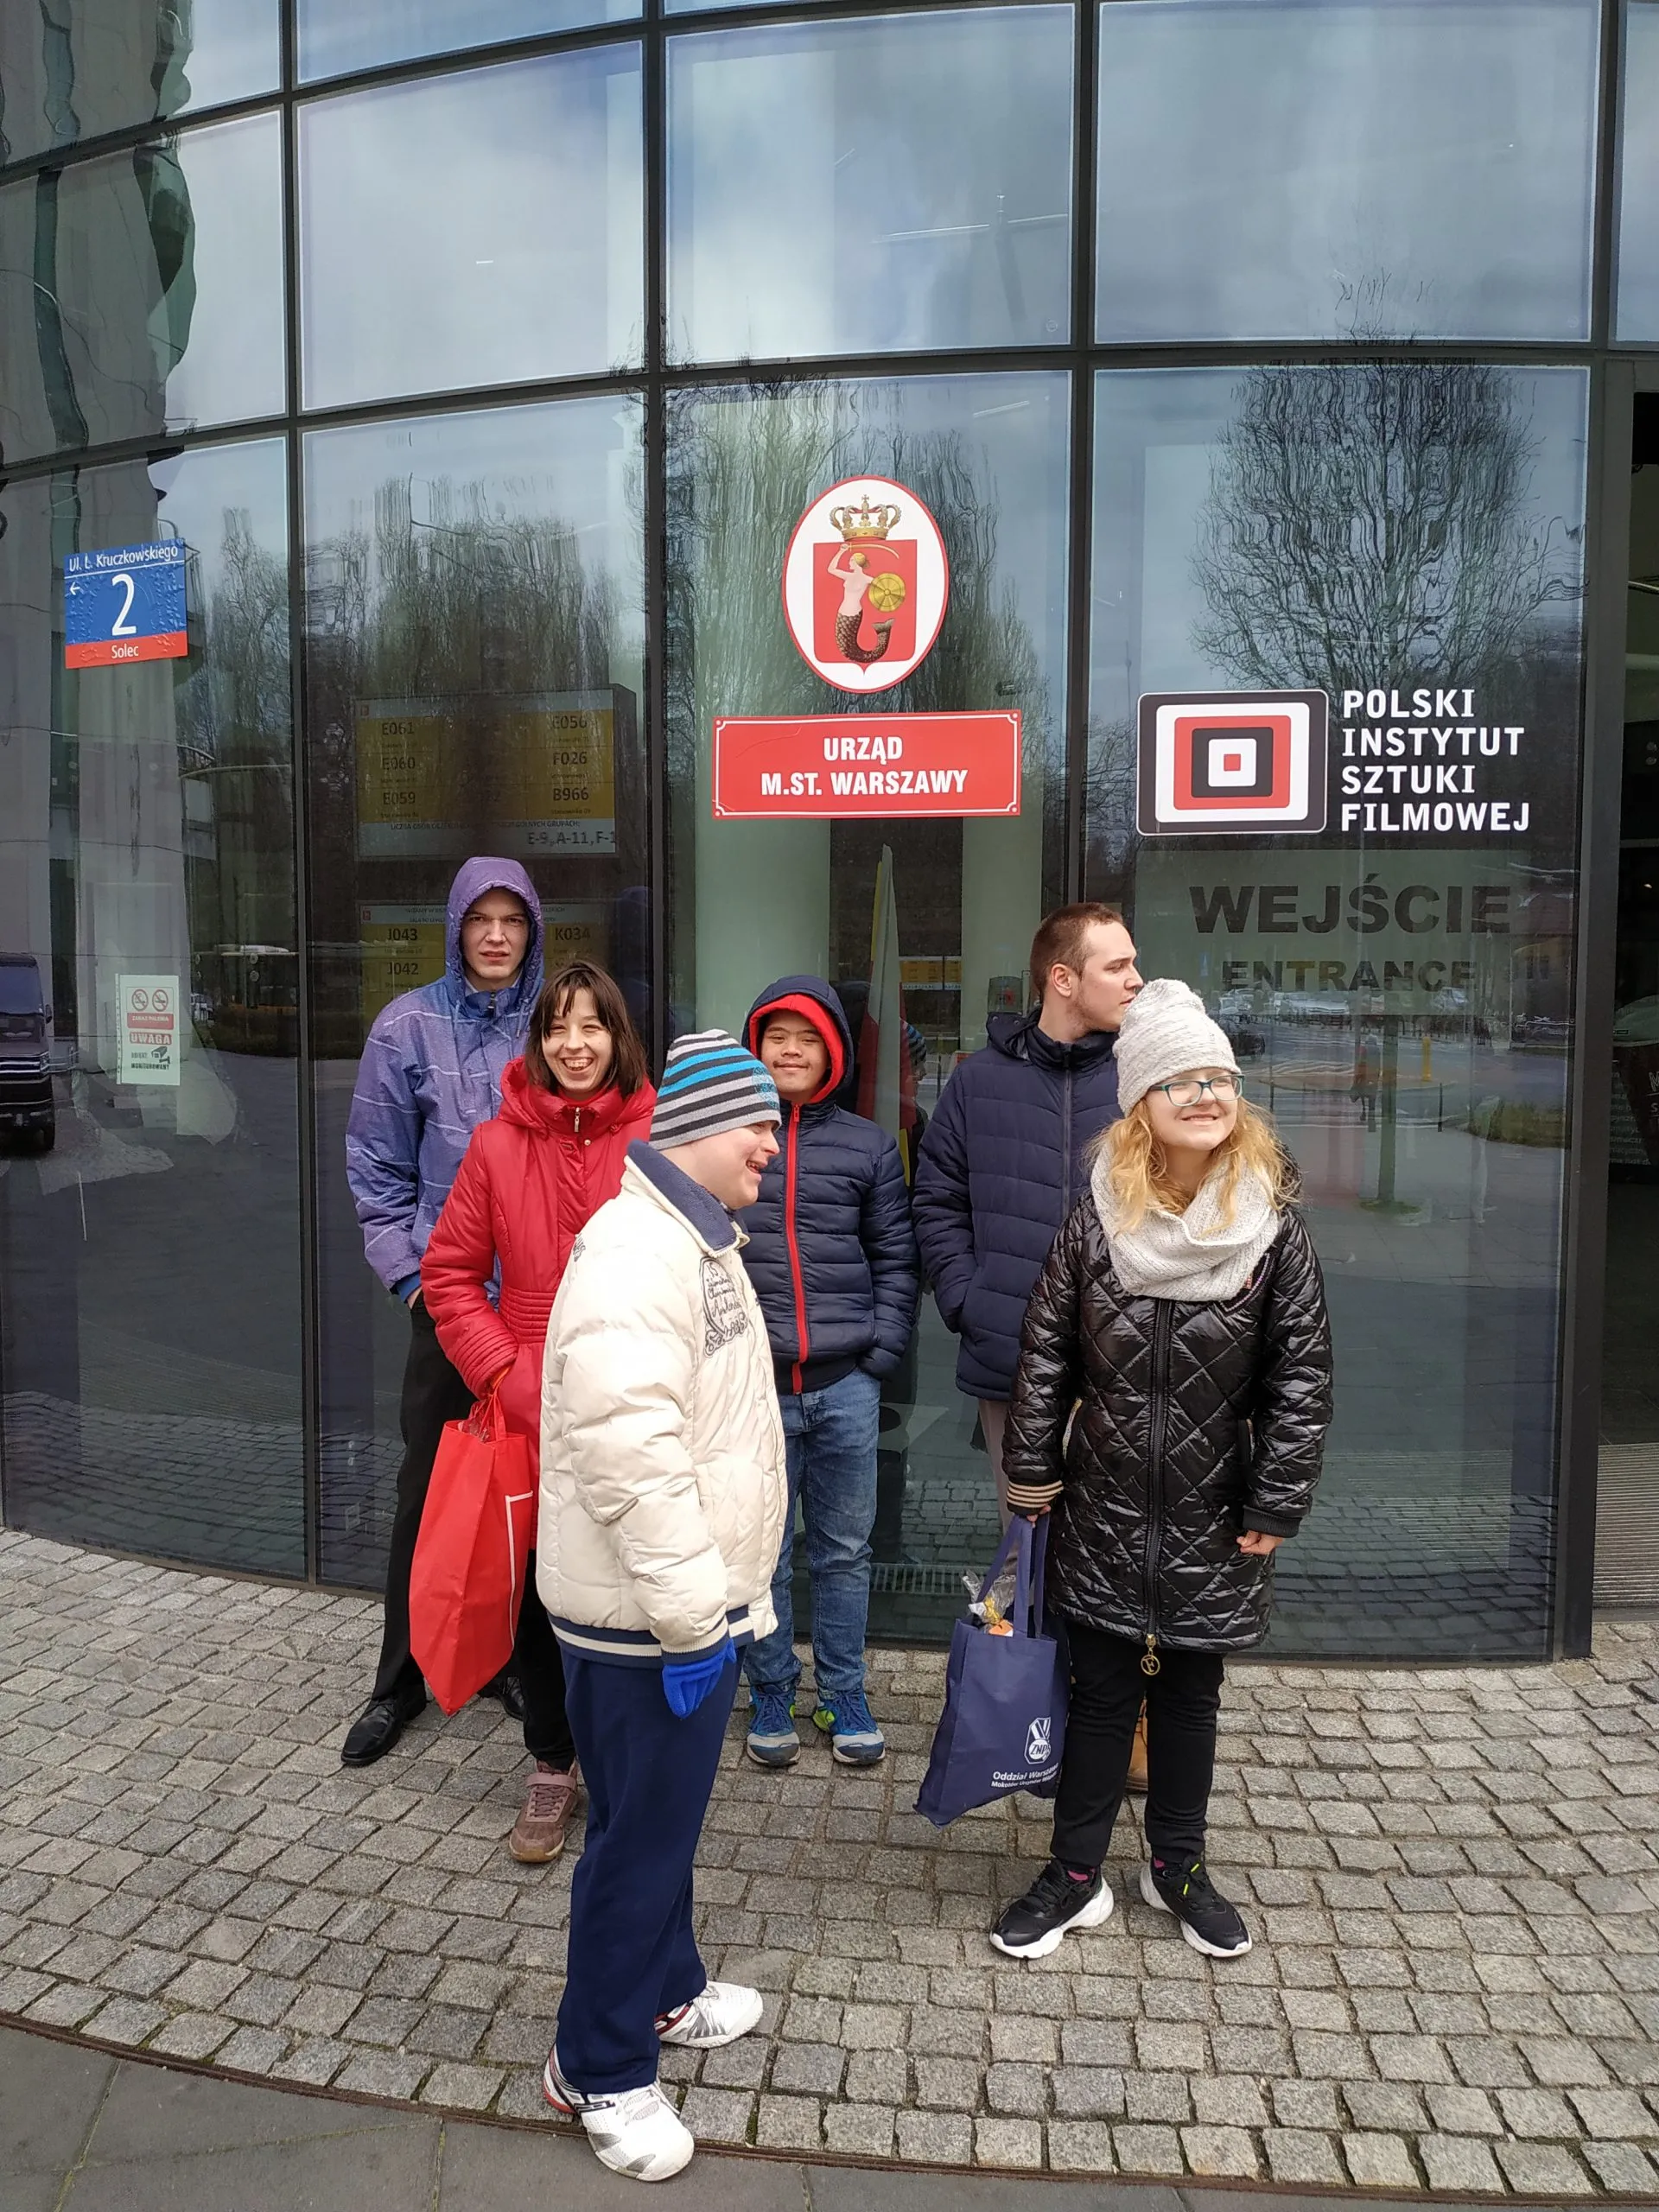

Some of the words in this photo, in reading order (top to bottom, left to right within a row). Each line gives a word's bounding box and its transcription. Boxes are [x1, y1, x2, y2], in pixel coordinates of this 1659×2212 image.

[68, 557, 82, 572] Ul.
[96, 545, 178, 568] Kruczkowskiego
[111, 573, 137, 637] 2
[111, 644, 139, 659] Solec
[1342, 688, 1476, 719] POLSKI
[381, 721, 415, 735] E061
[823, 735, 904, 766] URZĄD
[1341, 727, 1525, 757] INSTYTUT
[552, 751, 588, 766] F026
[760, 772, 823, 796] M.ST.
[830, 769, 969, 795] WARSZAWY
[1341, 765, 1476, 795] SZTUKI
[382, 791, 416, 805] E059
[552, 787, 590, 802] B966
[1341, 802, 1530, 832] FILMOWEJ
[1189, 873, 1511, 934] WEJŚCIE
[555, 927, 591, 941] K034
[1222, 960, 1478, 992] ENTRANCE
[130, 1033, 171, 1045] UWAGA
[1030, 1744, 1047, 1755] ZNP
